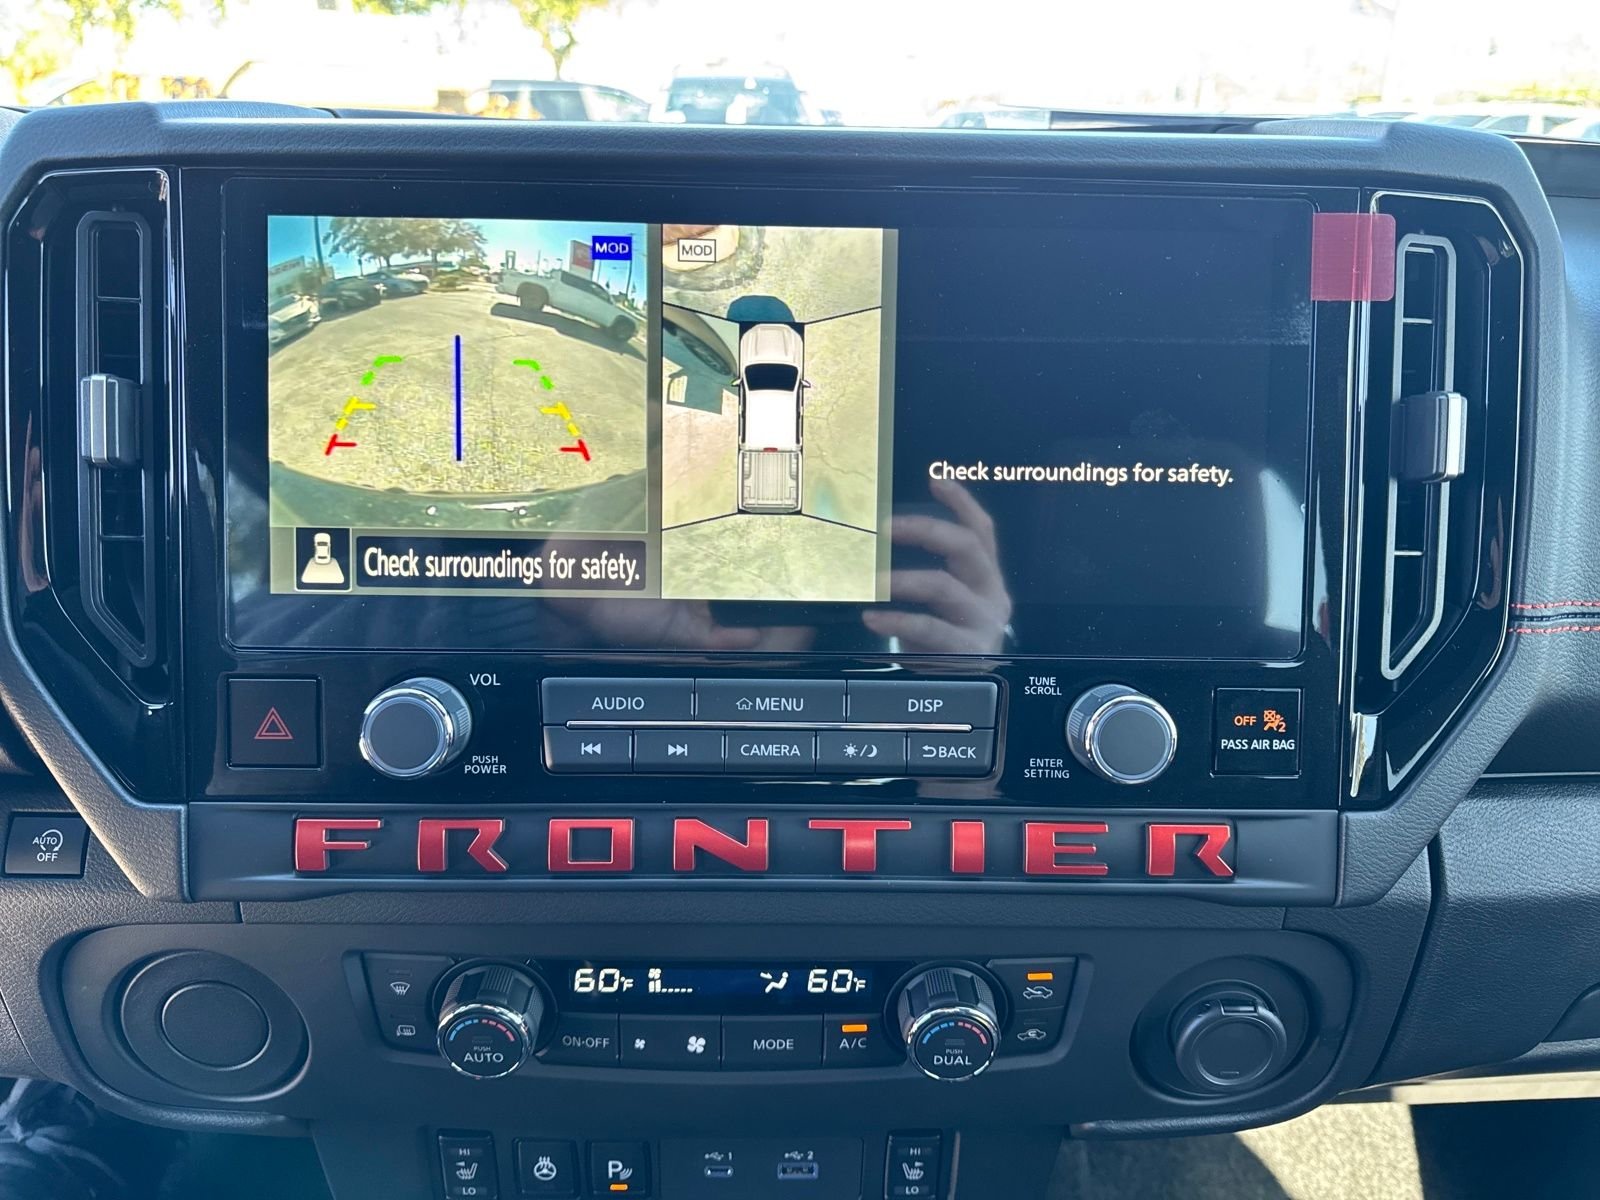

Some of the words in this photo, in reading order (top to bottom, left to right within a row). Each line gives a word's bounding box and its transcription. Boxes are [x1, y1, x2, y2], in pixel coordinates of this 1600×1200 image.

[595, 241, 629, 254] MOD
[681, 244, 713, 257] MOD
[929, 461, 967, 480] Check
[993, 462, 1127, 486] surroundings
[1132, 463, 1164, 482] for
[1167, 463, 1234, 487] safety.
[364, 547, 419, 578] Check
[425, 549, 542, 584] surroundings
[549, 550, 577, 580] for
[581, 551, 640, 586] safety.
[470, 673, 501, 686] VOL
[1029, 677, 1056, 685] TUNE
[1024, 686, 1062, 696] SCROLL
[591, 697, 645, 711] AUDIO
[755, 697, 804, 712] MENU
[908, 699, 944, 713] DISP
[1234, 715, 1257, 727] OFF
[1221, 739, 1248, 750] PASS
[1250, 739, 1270, 750] AIR
[1272, 740, 1295, 750] BAG
[740, 744, 800, 758] CAMERA
[939, 746, 977, 759] BACK
[471, 755, 499, 764] PUSH
[1030, 758, 1063, 768] ENTER
[464, 764, 507, 775] POWER
[1024, 769, 1070, 779] SETTING
[32, 836, 58, 846] AUTO
[294, 818, 1236, 877] FRONTIER
[36, 852, 58, 862] OFF
[753, 1038, 794, 1051] MODE
[839, 1037, 867, 1050] A/C
[463, 1052, 504, 1064] AUTO
[933, 1055, 972, 1066] DUAL
[459, 1148, 471, 1156] HI
[909, 1147, 921, 1156] HI
[462, 1186, 476, 1196] LO
[905, 1185, 919, 1195] LO
